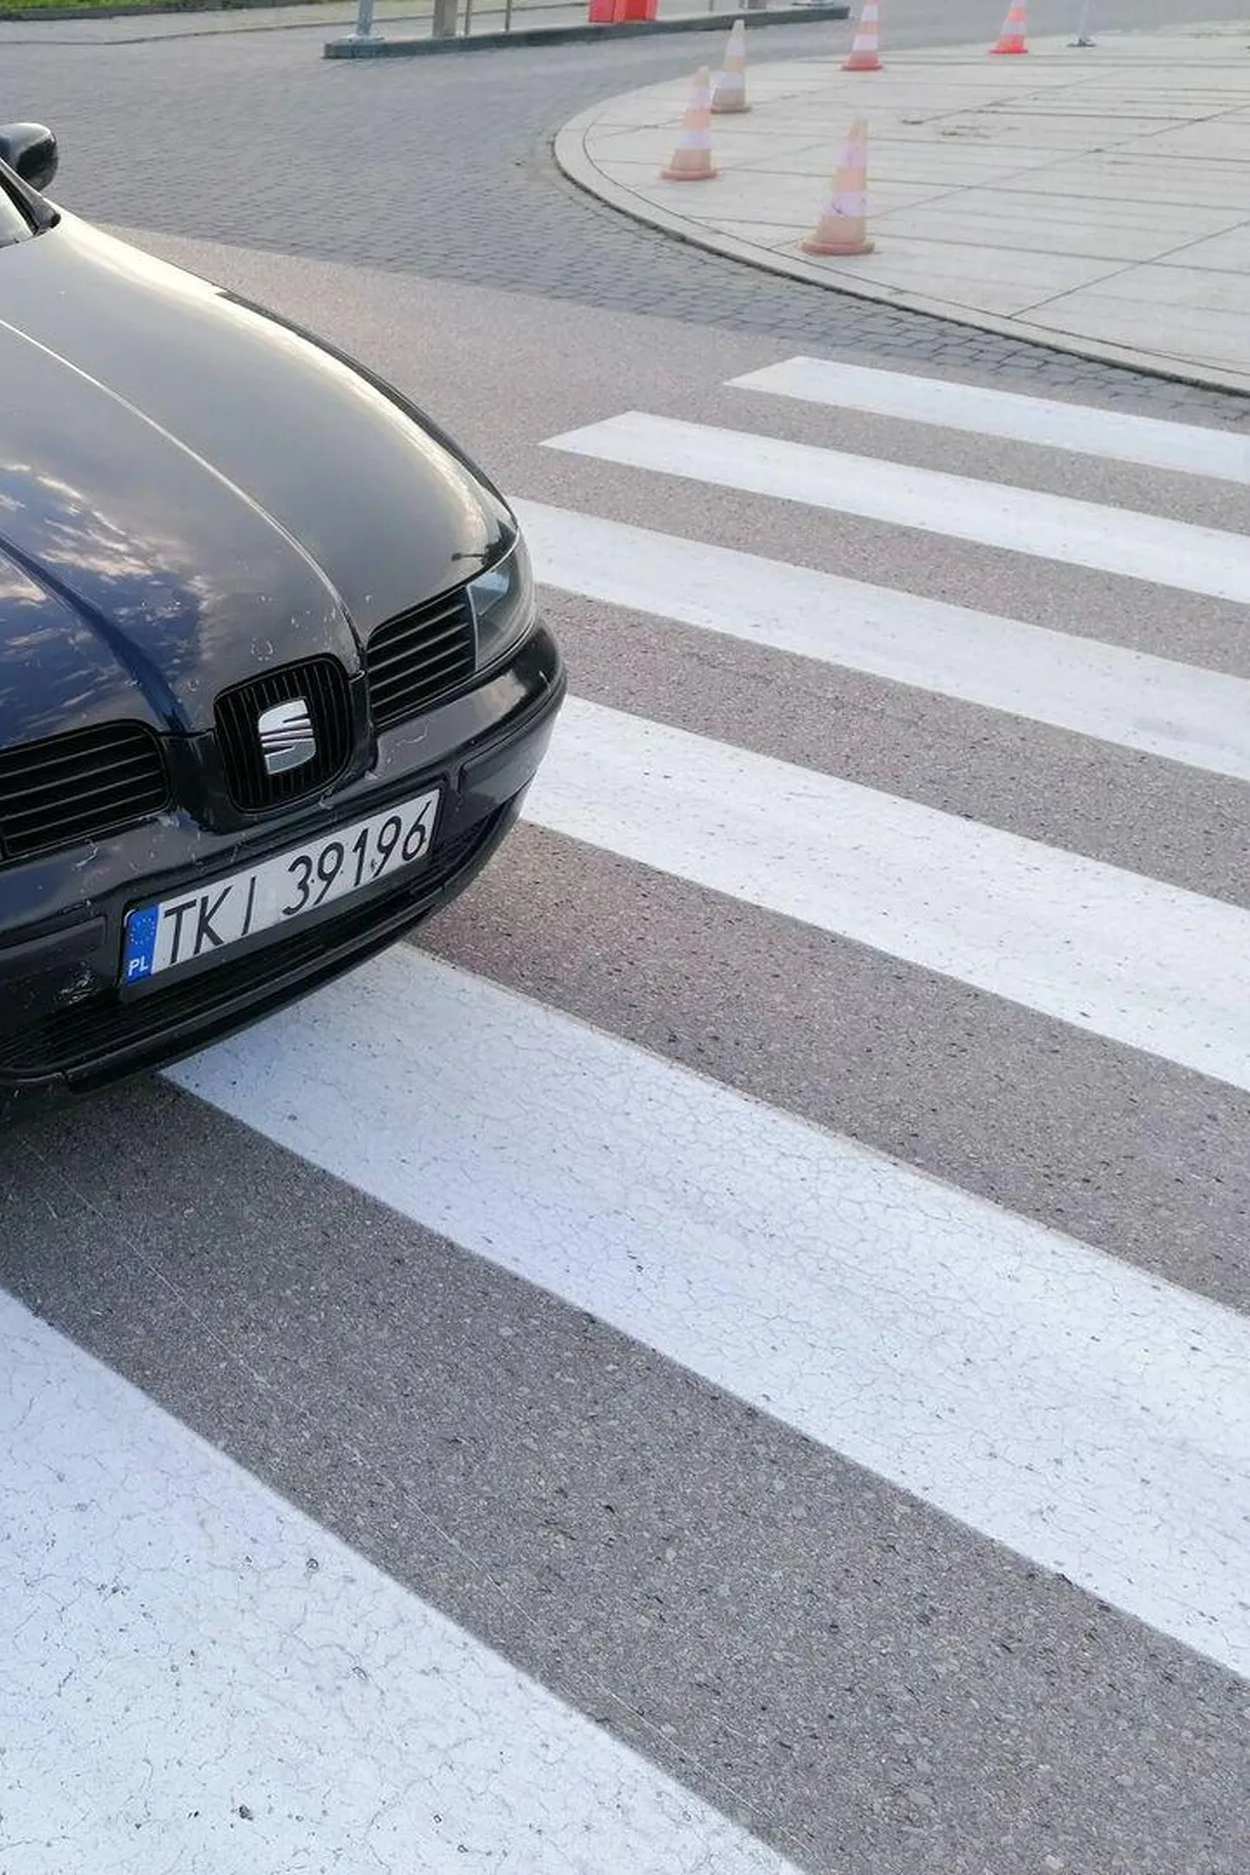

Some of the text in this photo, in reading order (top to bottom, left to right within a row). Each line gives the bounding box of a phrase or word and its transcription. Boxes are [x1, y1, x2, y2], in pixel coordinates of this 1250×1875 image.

[163, 799, 432, 965] TKI 39196
[128, 957, 149, 977] PL
